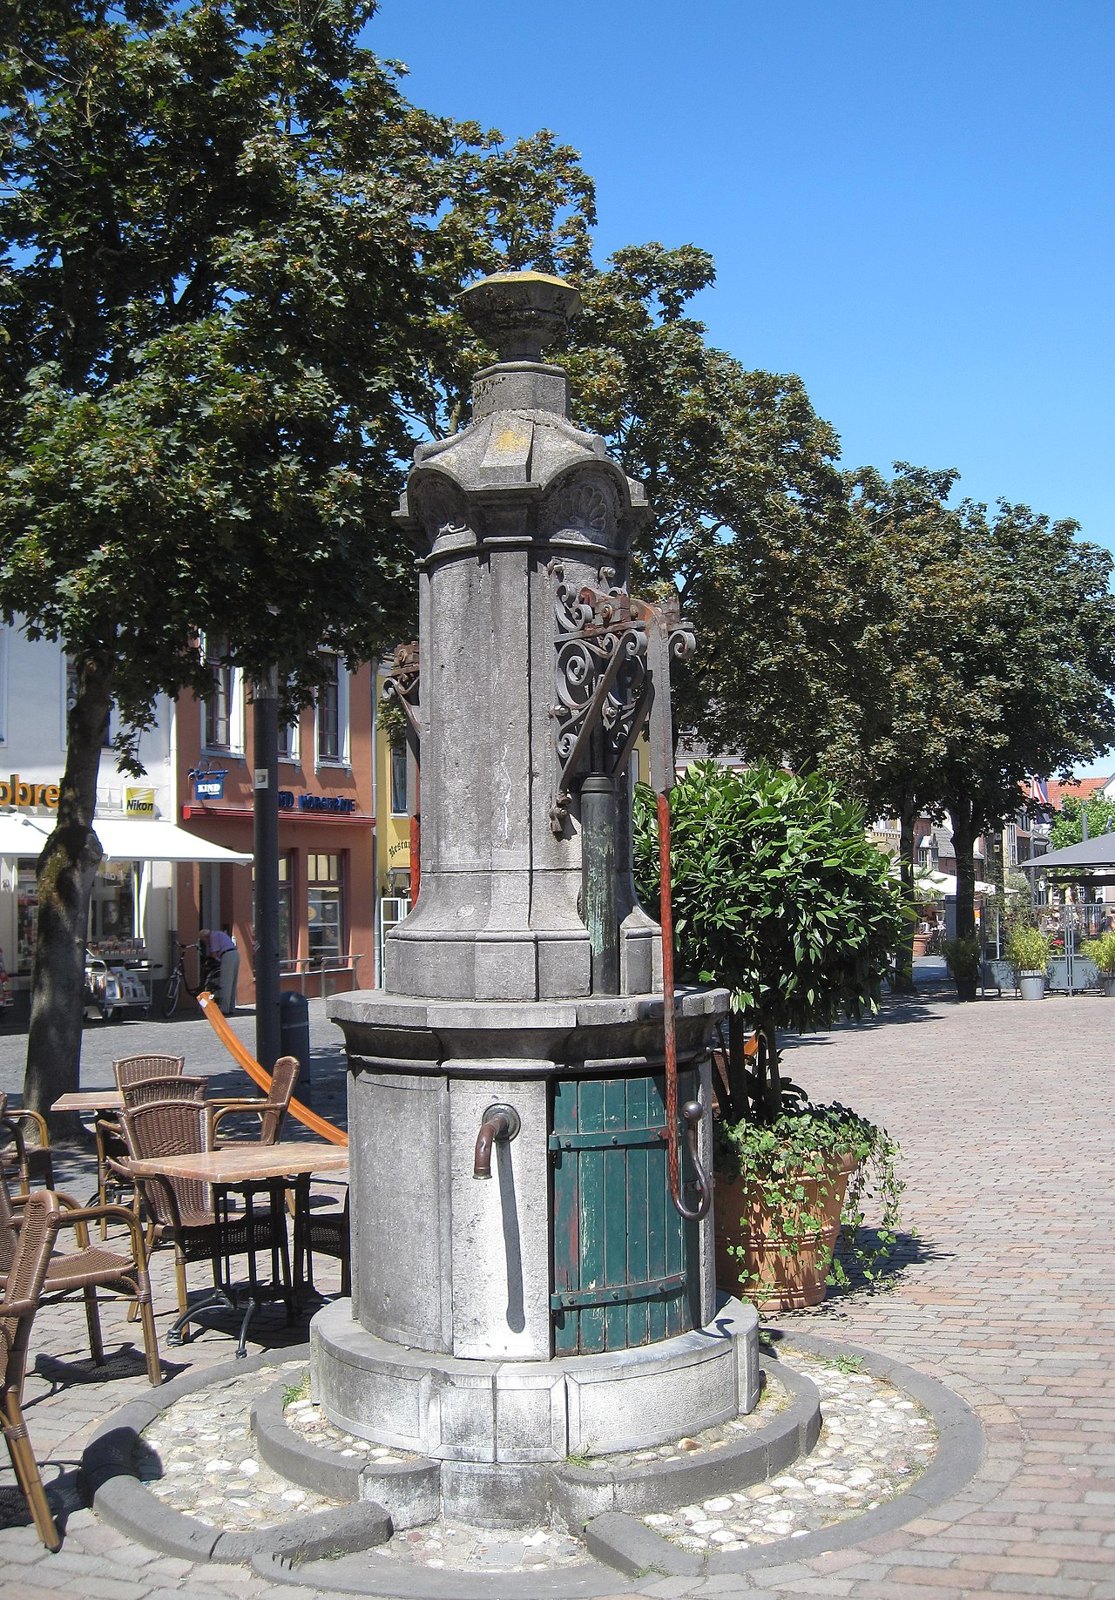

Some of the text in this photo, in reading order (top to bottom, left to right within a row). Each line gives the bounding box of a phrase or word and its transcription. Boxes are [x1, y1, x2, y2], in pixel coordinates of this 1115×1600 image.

[0, 773, 64, 809] obre
[197, 783, 221, 793] KIND
[126, 799, 154, 812] Nikon
